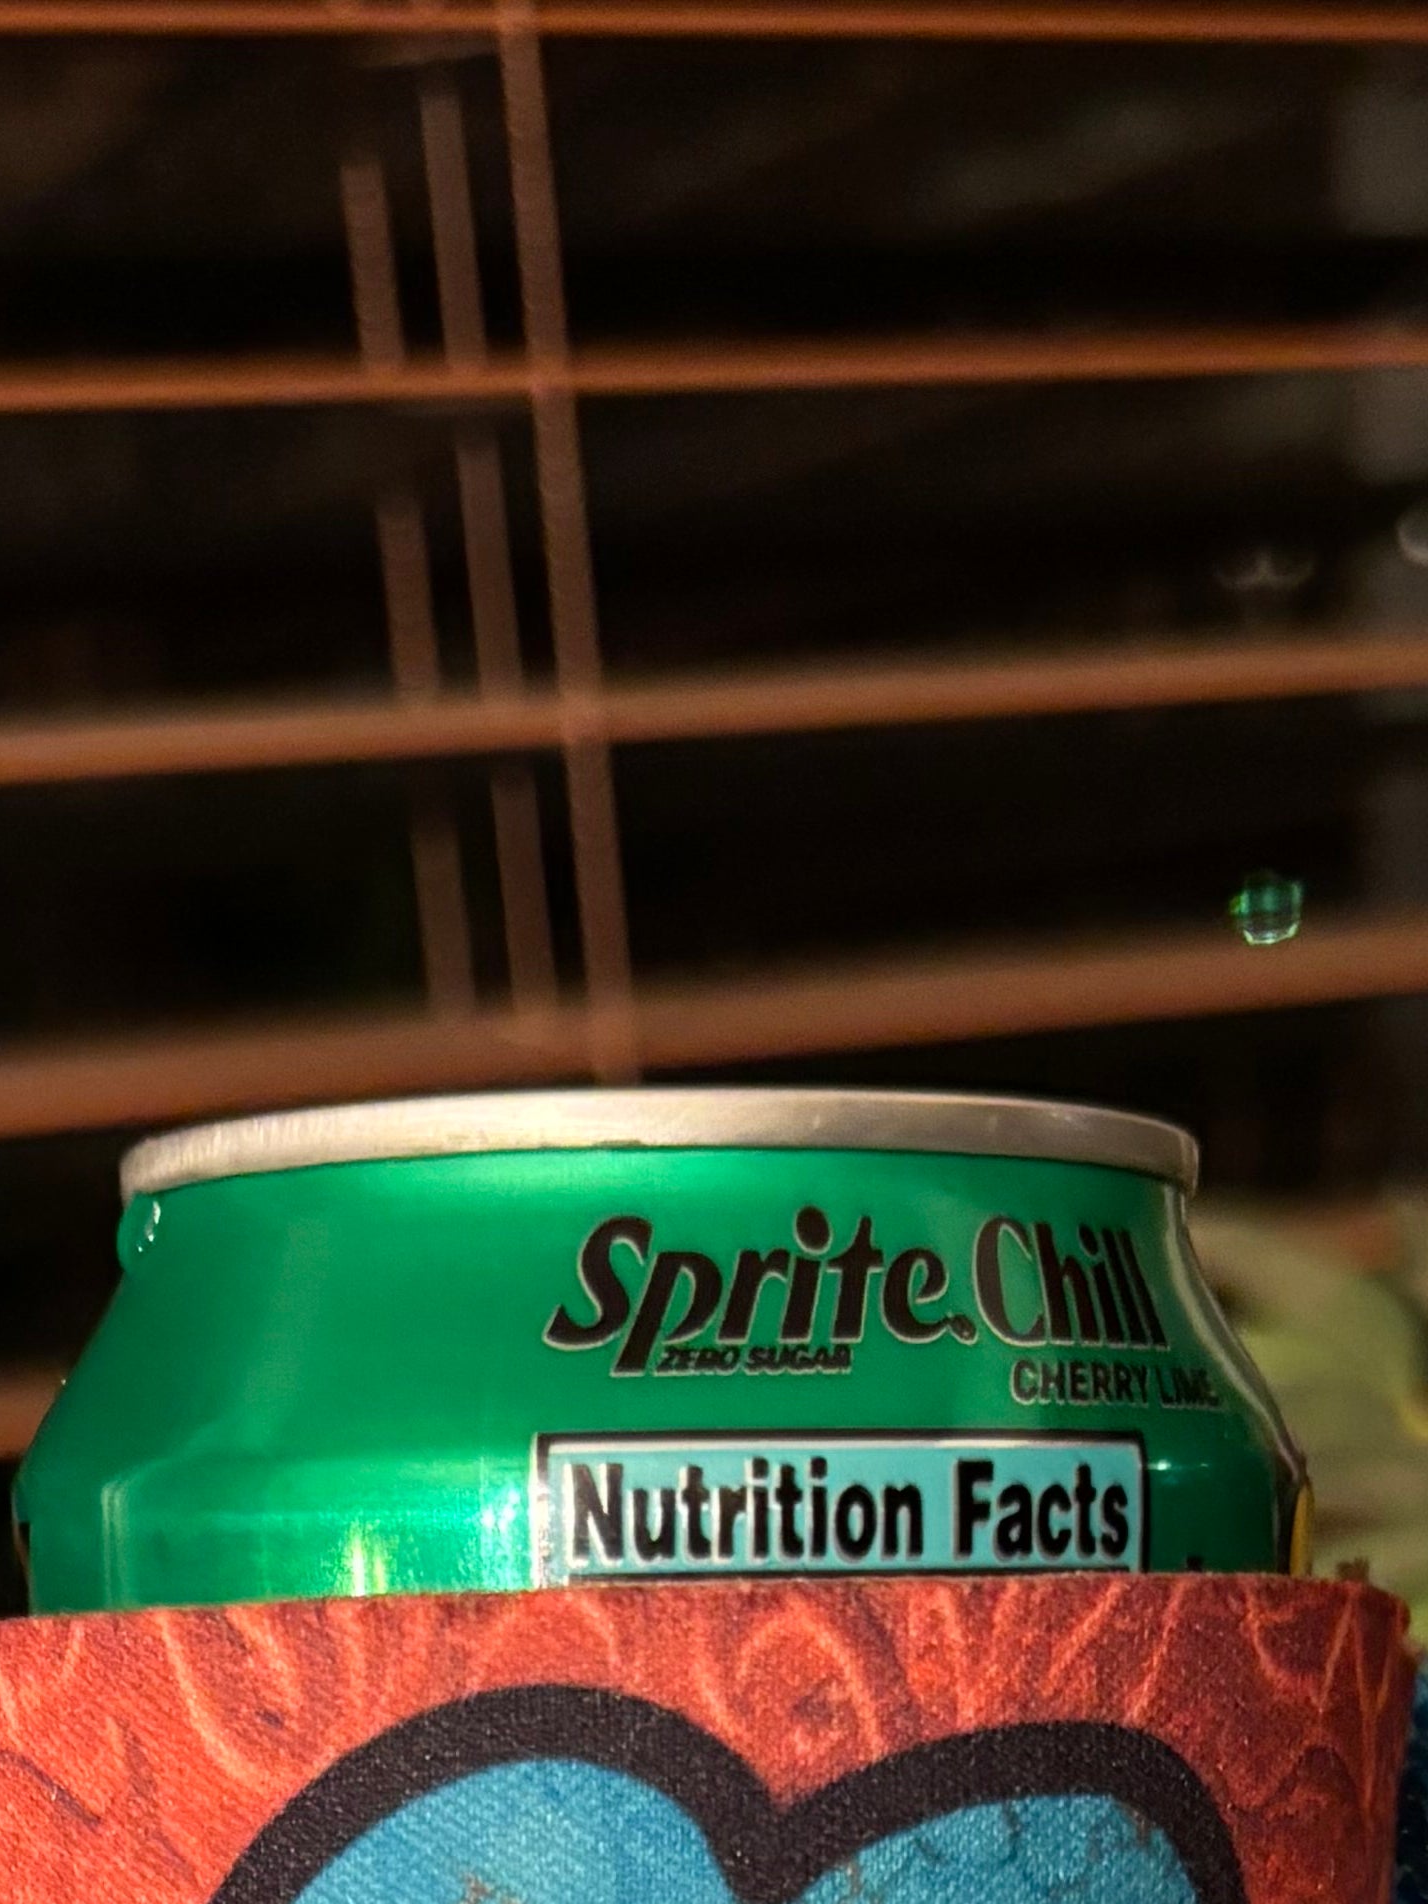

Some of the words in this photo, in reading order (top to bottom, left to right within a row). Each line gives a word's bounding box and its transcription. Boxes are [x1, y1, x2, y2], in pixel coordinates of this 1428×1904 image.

[543, 1206, 972, 1377] Sprite
[975, 1213, 1169, 1350] Chill
[655, 1345, 740, 1376] ZERO
[743, 1345, 853, 1375] SUGAR
[1011, 1359, 1149, 1406] CHERRY
[569, 1457, 924, 1564] Nutrition
[953, 1459, 1129, 1561] Facts
